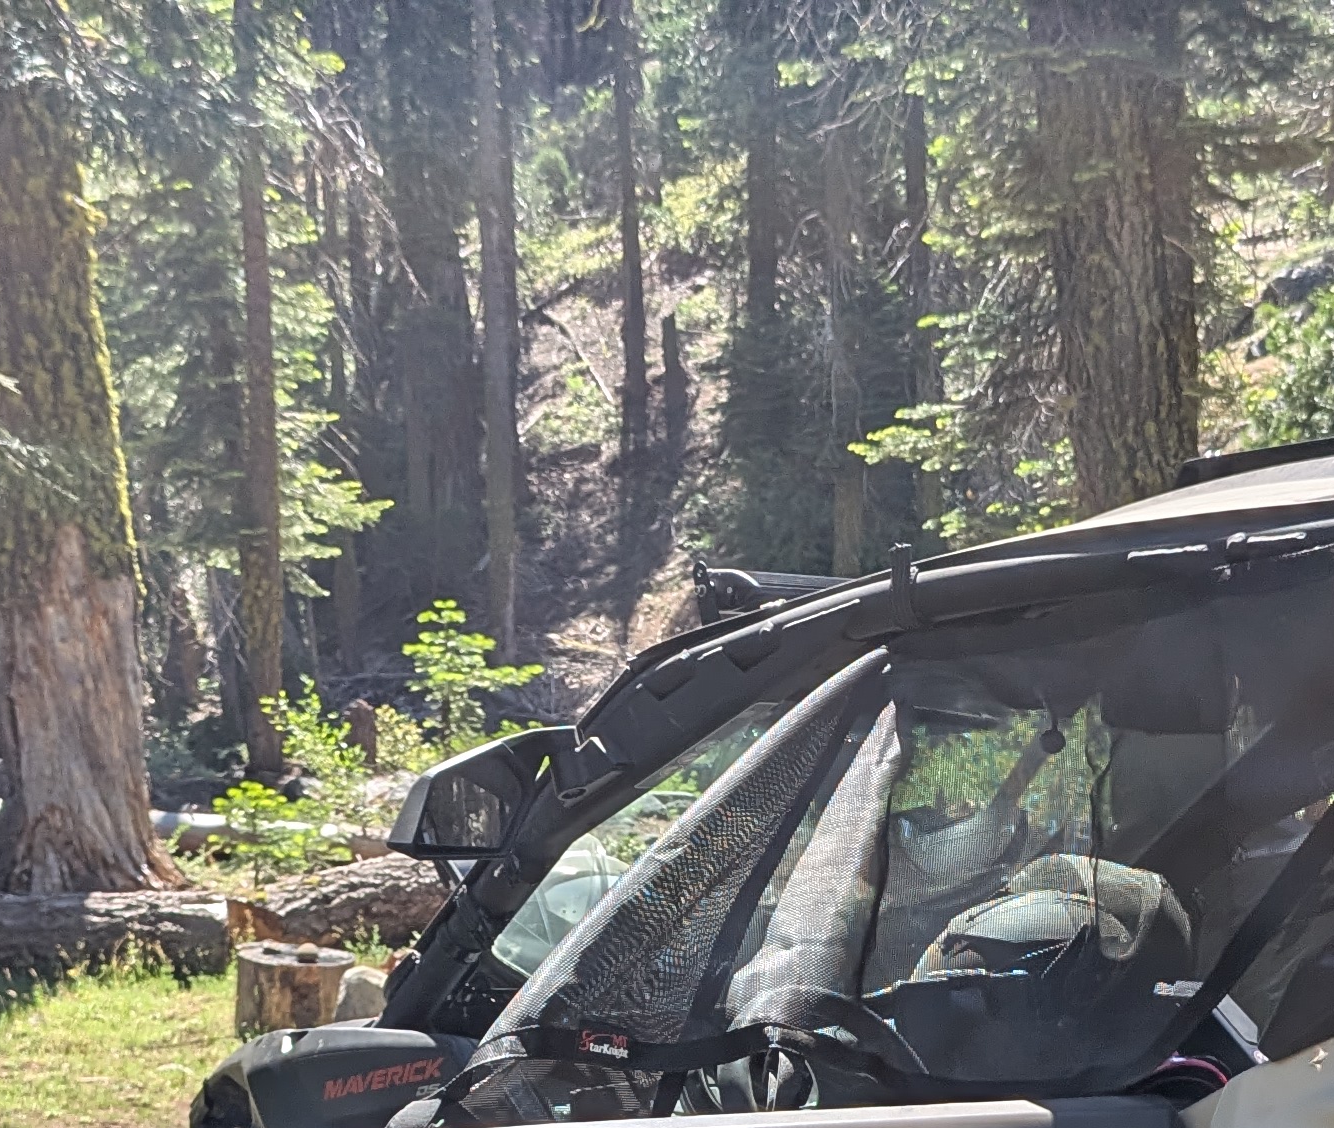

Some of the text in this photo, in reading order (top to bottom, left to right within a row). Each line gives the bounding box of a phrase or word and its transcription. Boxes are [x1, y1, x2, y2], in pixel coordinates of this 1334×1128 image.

[579, 1030, 629, 1059] StarKnight
[612, 1034, 628, 1048] MT
[324, 1057, 444, 1100] MAVERICK
